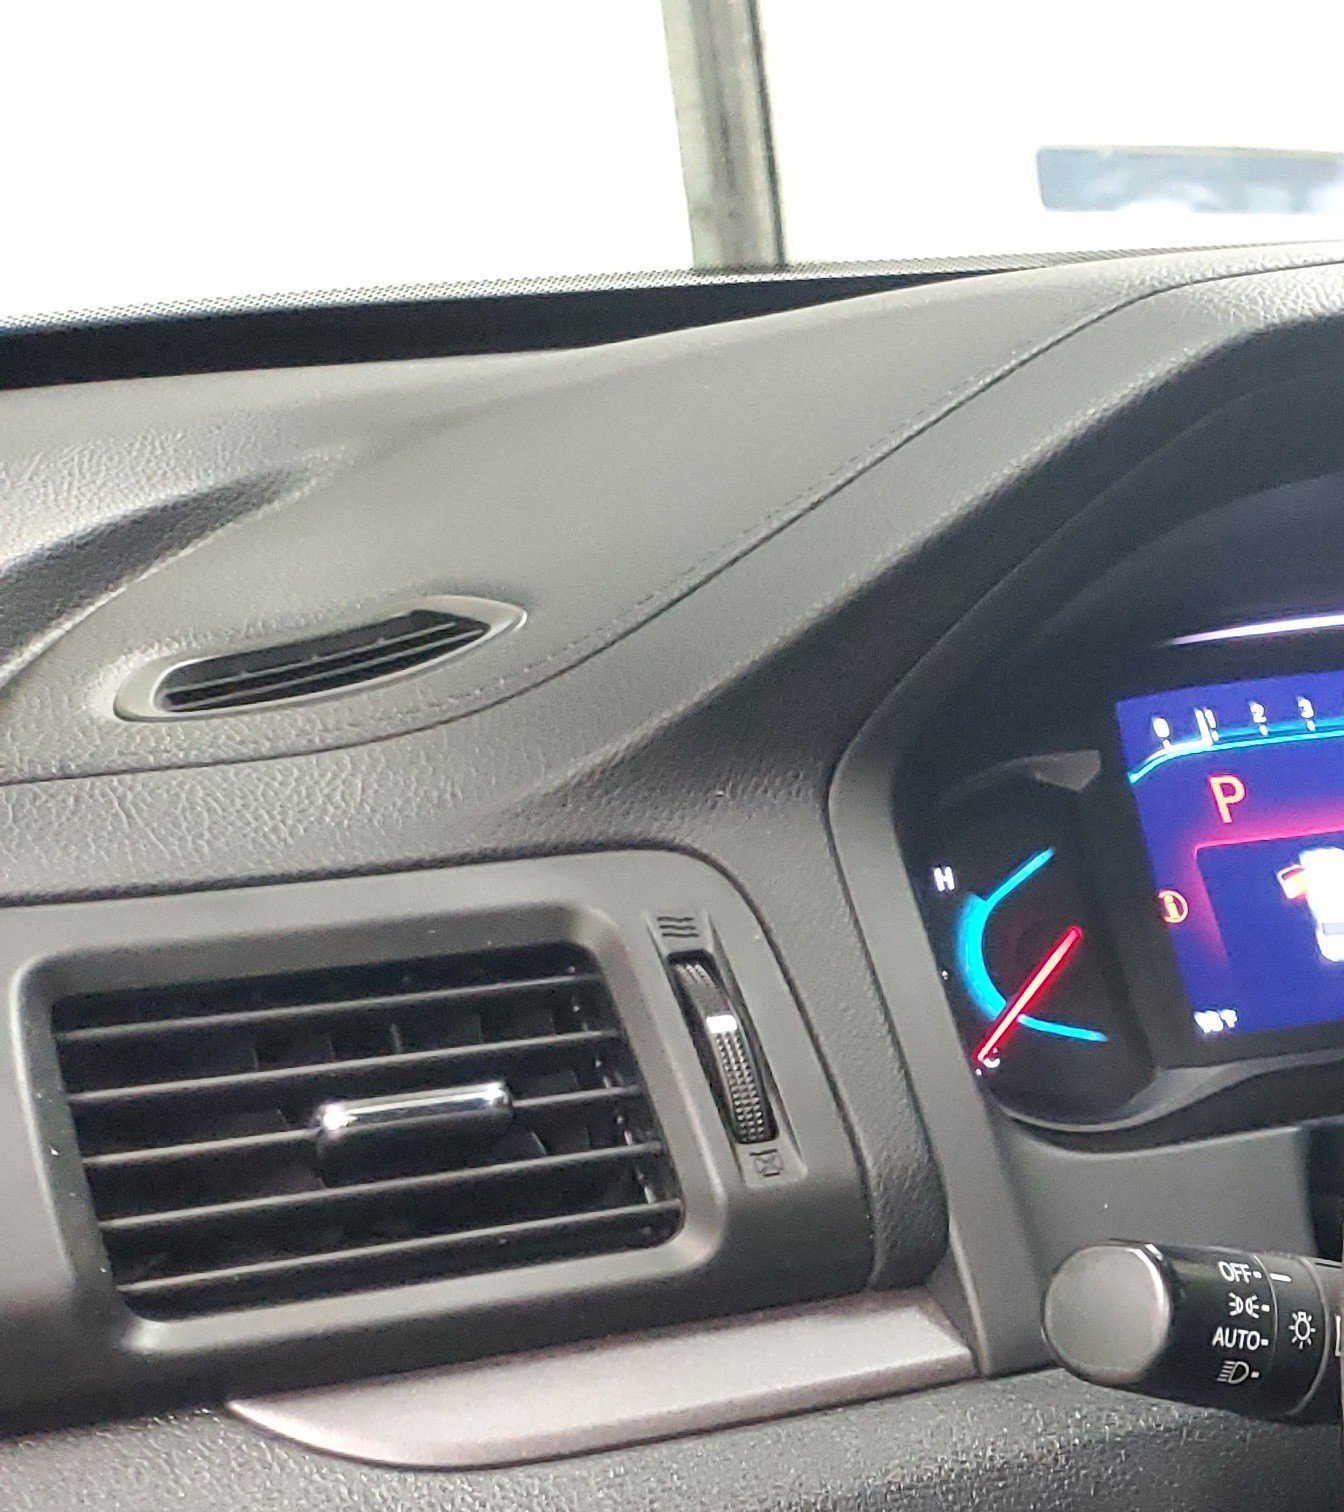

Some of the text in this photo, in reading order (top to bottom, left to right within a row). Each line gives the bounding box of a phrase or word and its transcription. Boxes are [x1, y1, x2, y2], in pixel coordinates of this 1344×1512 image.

[1249, 702, 1267, 723] 2
[1297, 697, 1314, 718] 3
[1207, 774, 1247, 823] P
[933, 866, 956, 892] H
[1217, 1261, 1252, 1284] OFF
[1212, 1327, 1262, 1350] AUTO
